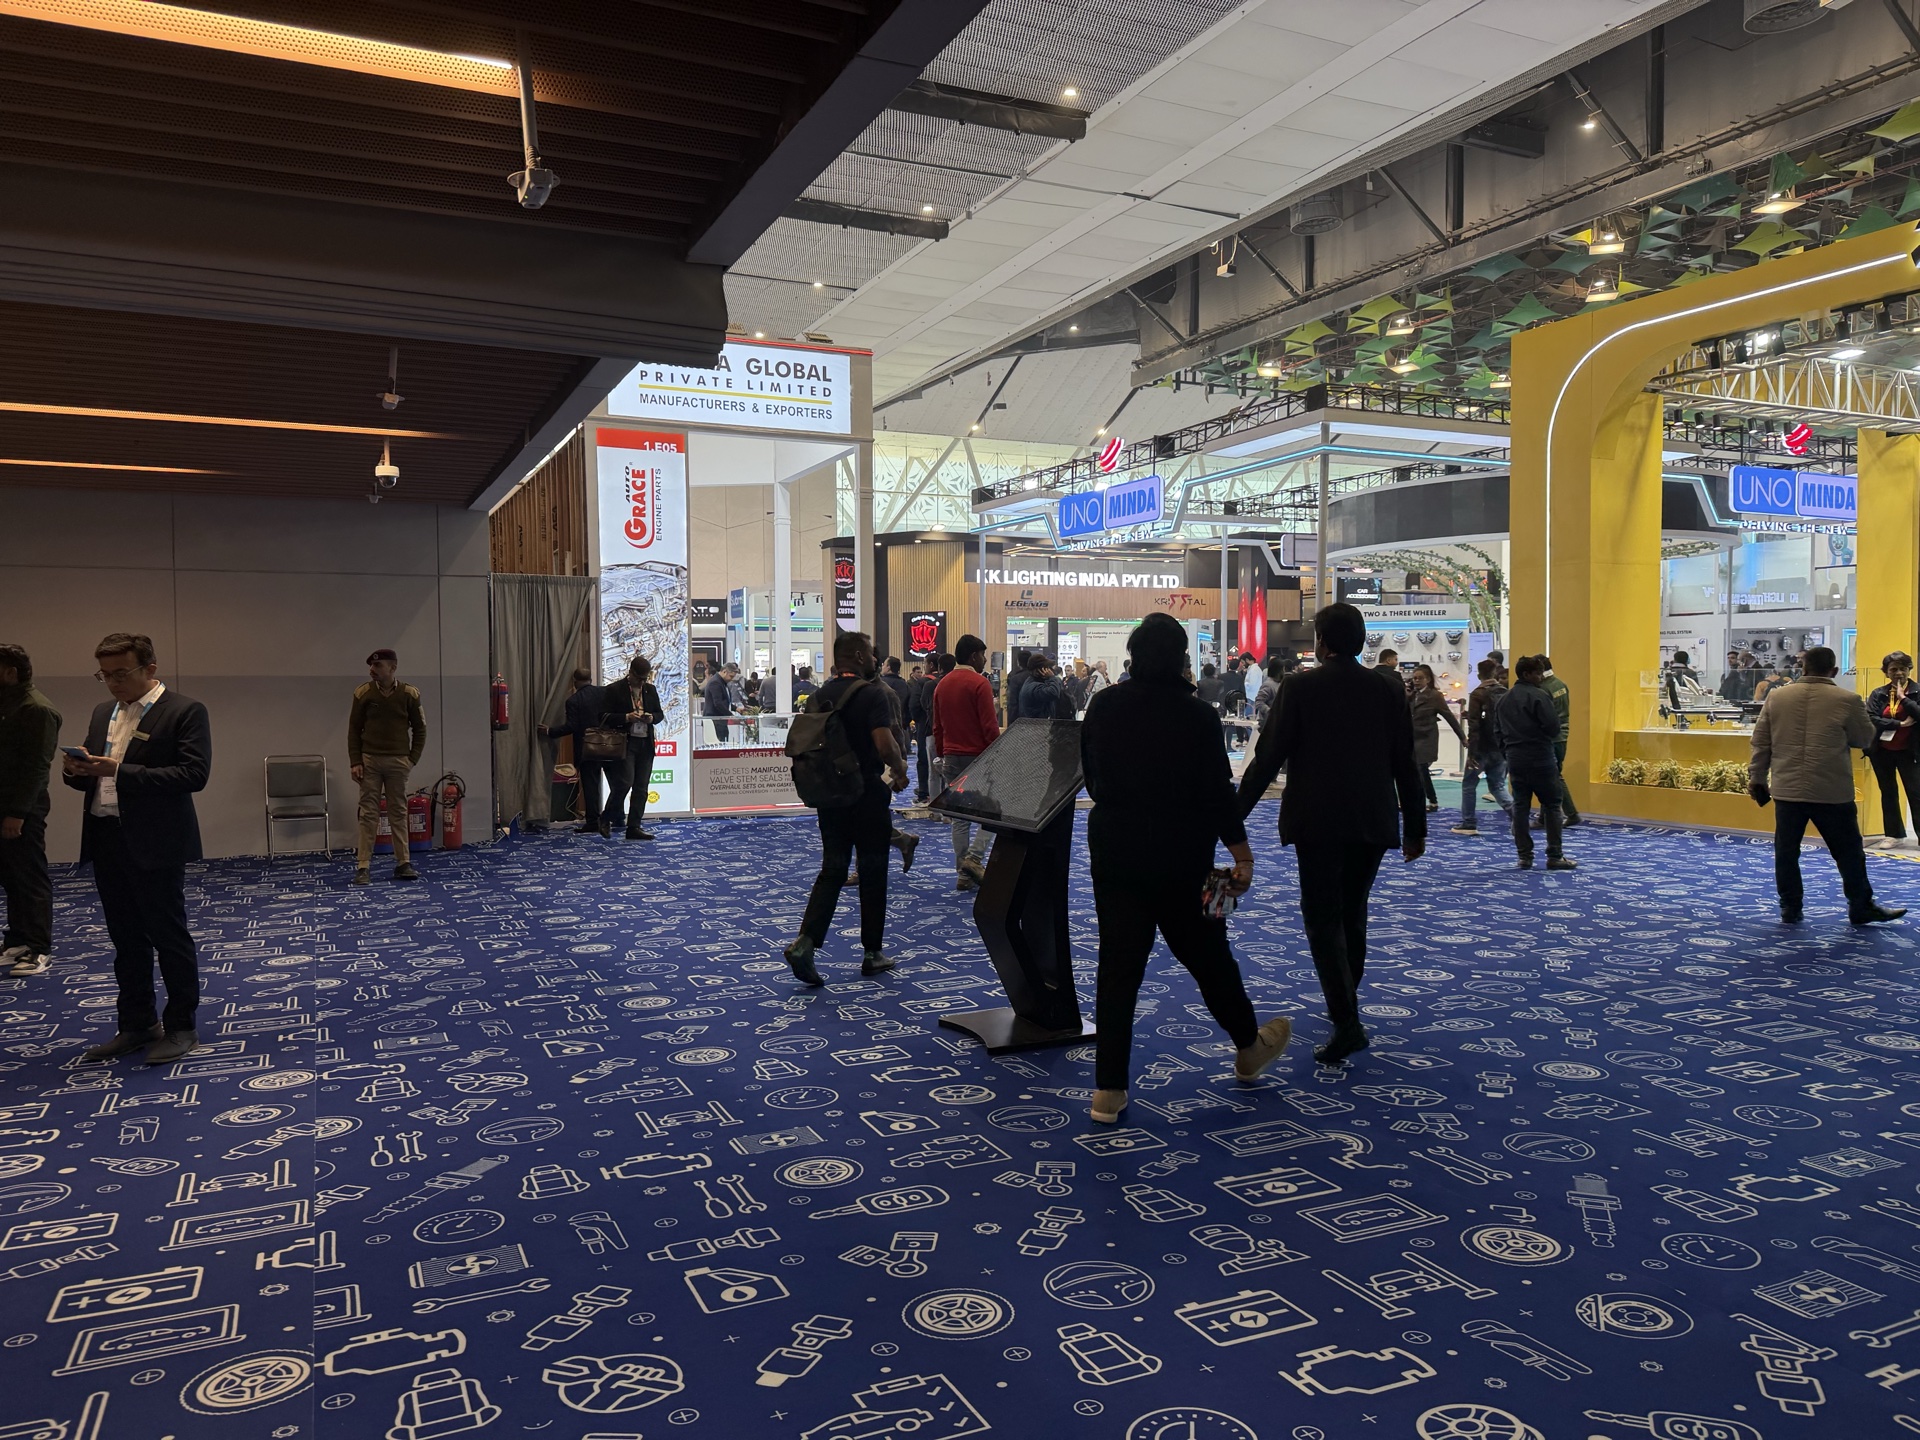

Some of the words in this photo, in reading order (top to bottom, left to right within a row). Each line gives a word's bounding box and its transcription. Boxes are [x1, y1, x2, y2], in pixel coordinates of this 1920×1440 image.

[746, 357, 832, 382] GLOBAL
[640, 370, 733, 389] PRIVATE
[747, 380, 832, 398] LIMITED
[639, 393, 746, 412] MANUFACTURERS
[752, 403, 760, 413] &
[766, 404, 833, 420] EXPORTERS
[624, 469, 647, 541] GRACE
[1739, 474, 1793, 508] UNO
[1801, 482, 1856, 511] MINDA
[1063, 497, 1101, 531] UNO
[1108, 486, 1157, 520] MINDA
[655, 504, 663, 541] ENGINE
[1740, 519, 1793, 532] DRIVING
[1798, 524, 1820, 533] THE
[1823, 525, 1849, 535] NEW
[1003, 570, 1078, 586] LIGHTING
[1079, 573, 1119, 588] INDIA
[1122, 574, 1151, 588] PVT
[1152, 575, 1180, 589] LTD
[837, 607, 856, 615] CUSTO
[738, 751, 771, 759] GASKETS
[709, 776, 734, 784] VALVE
[736, 775, 758, 783] STEM
[759, 774, 783, 782] SEALS
[750, 766, 789, 774] MANIFOLD
